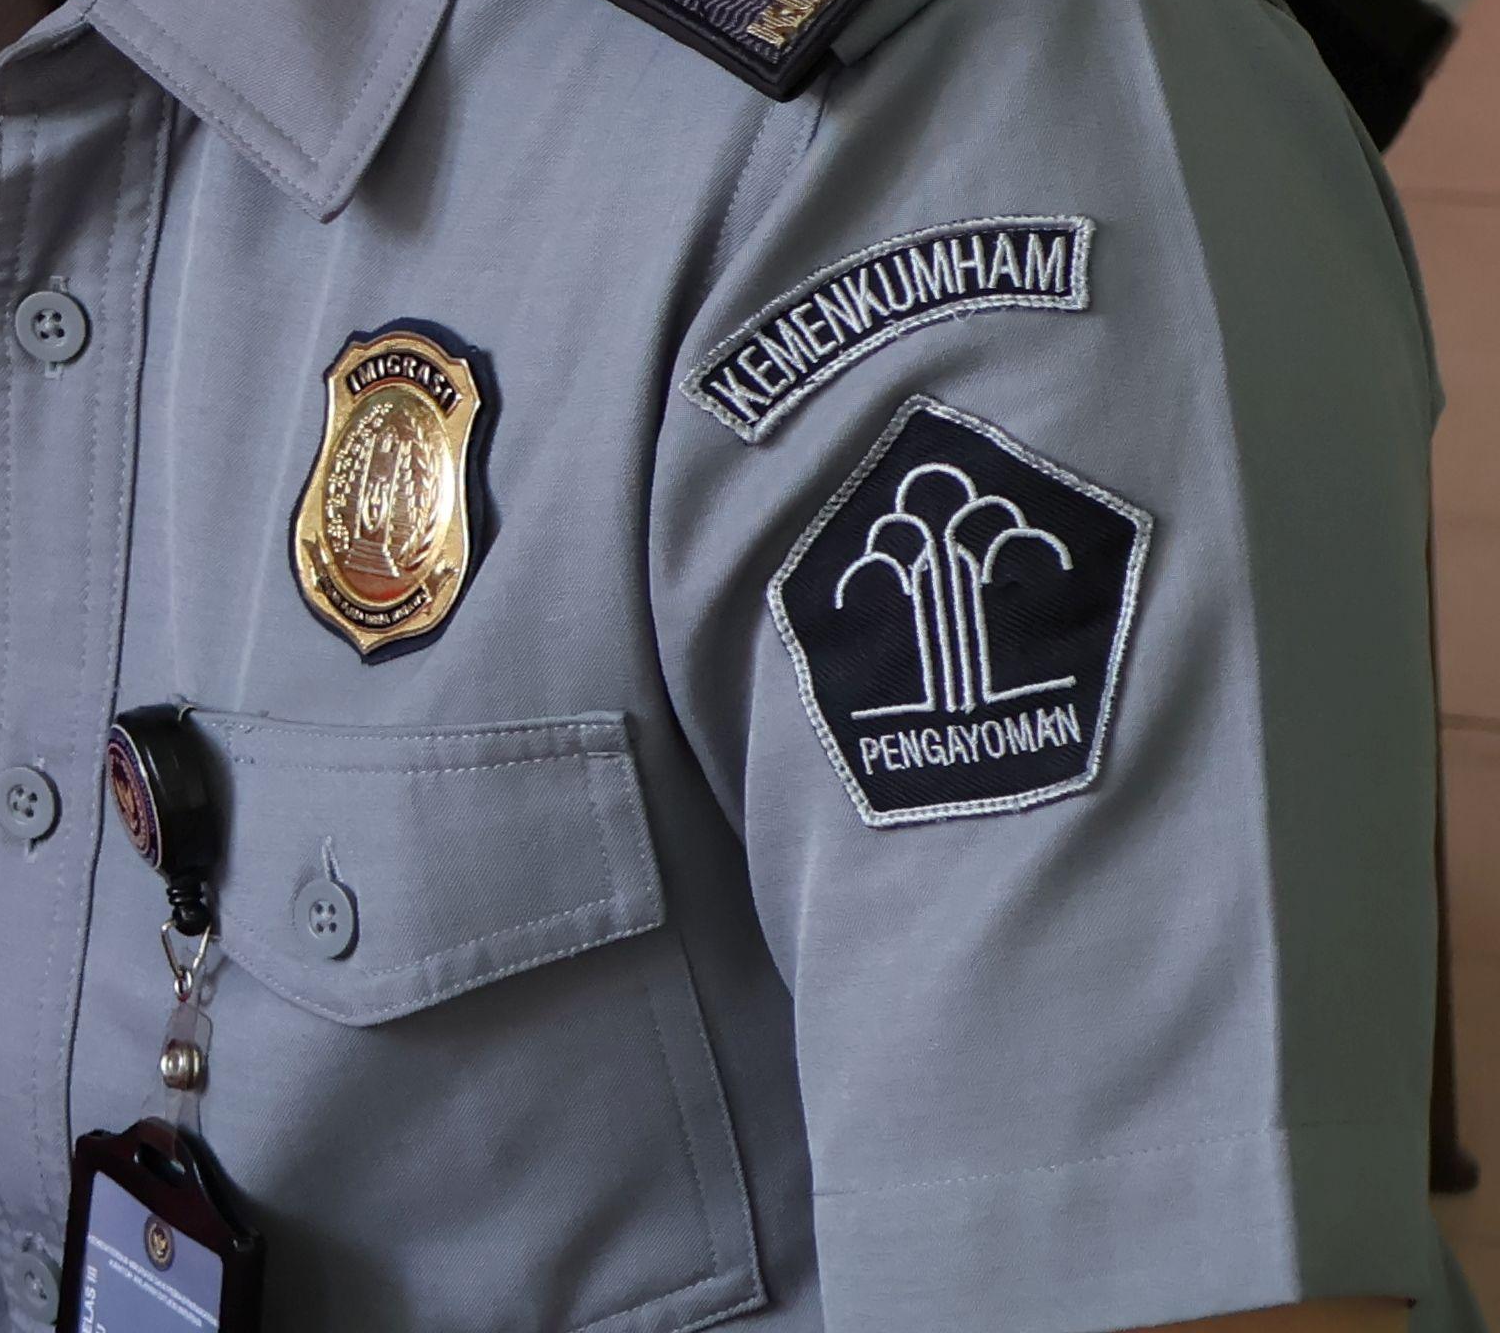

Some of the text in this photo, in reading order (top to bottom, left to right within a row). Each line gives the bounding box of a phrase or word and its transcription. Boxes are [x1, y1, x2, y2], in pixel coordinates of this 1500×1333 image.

[709, 232, 1068, 423] KEMENKUMHAM
[350, 353, 453, 406] IMIGRASI
[858, 703, 1083, 777] PENGAYOMAN
